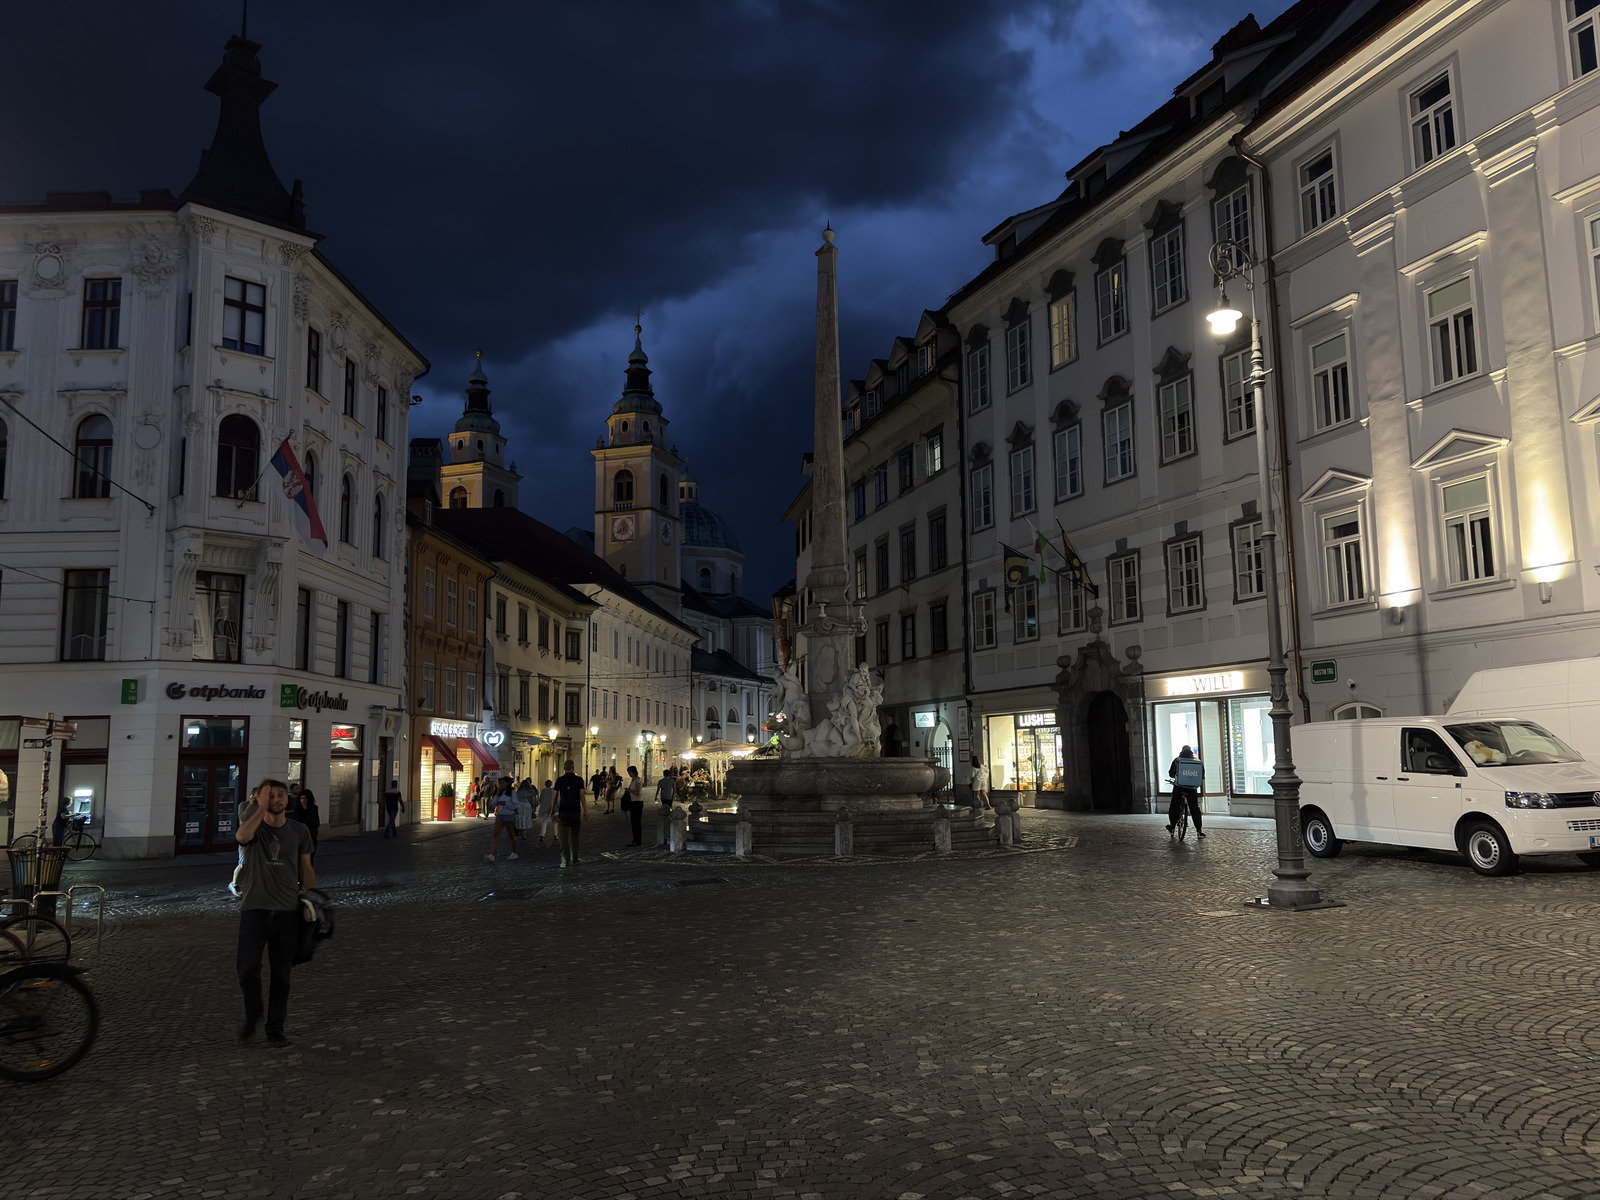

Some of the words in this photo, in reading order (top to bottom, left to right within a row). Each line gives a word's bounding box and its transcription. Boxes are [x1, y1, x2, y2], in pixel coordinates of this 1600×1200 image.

[189, 684, 266, 701] otpbanka
[1019, 713, 1044, 727] LUSH
[1182, 769, 1198, 777] Wolt
